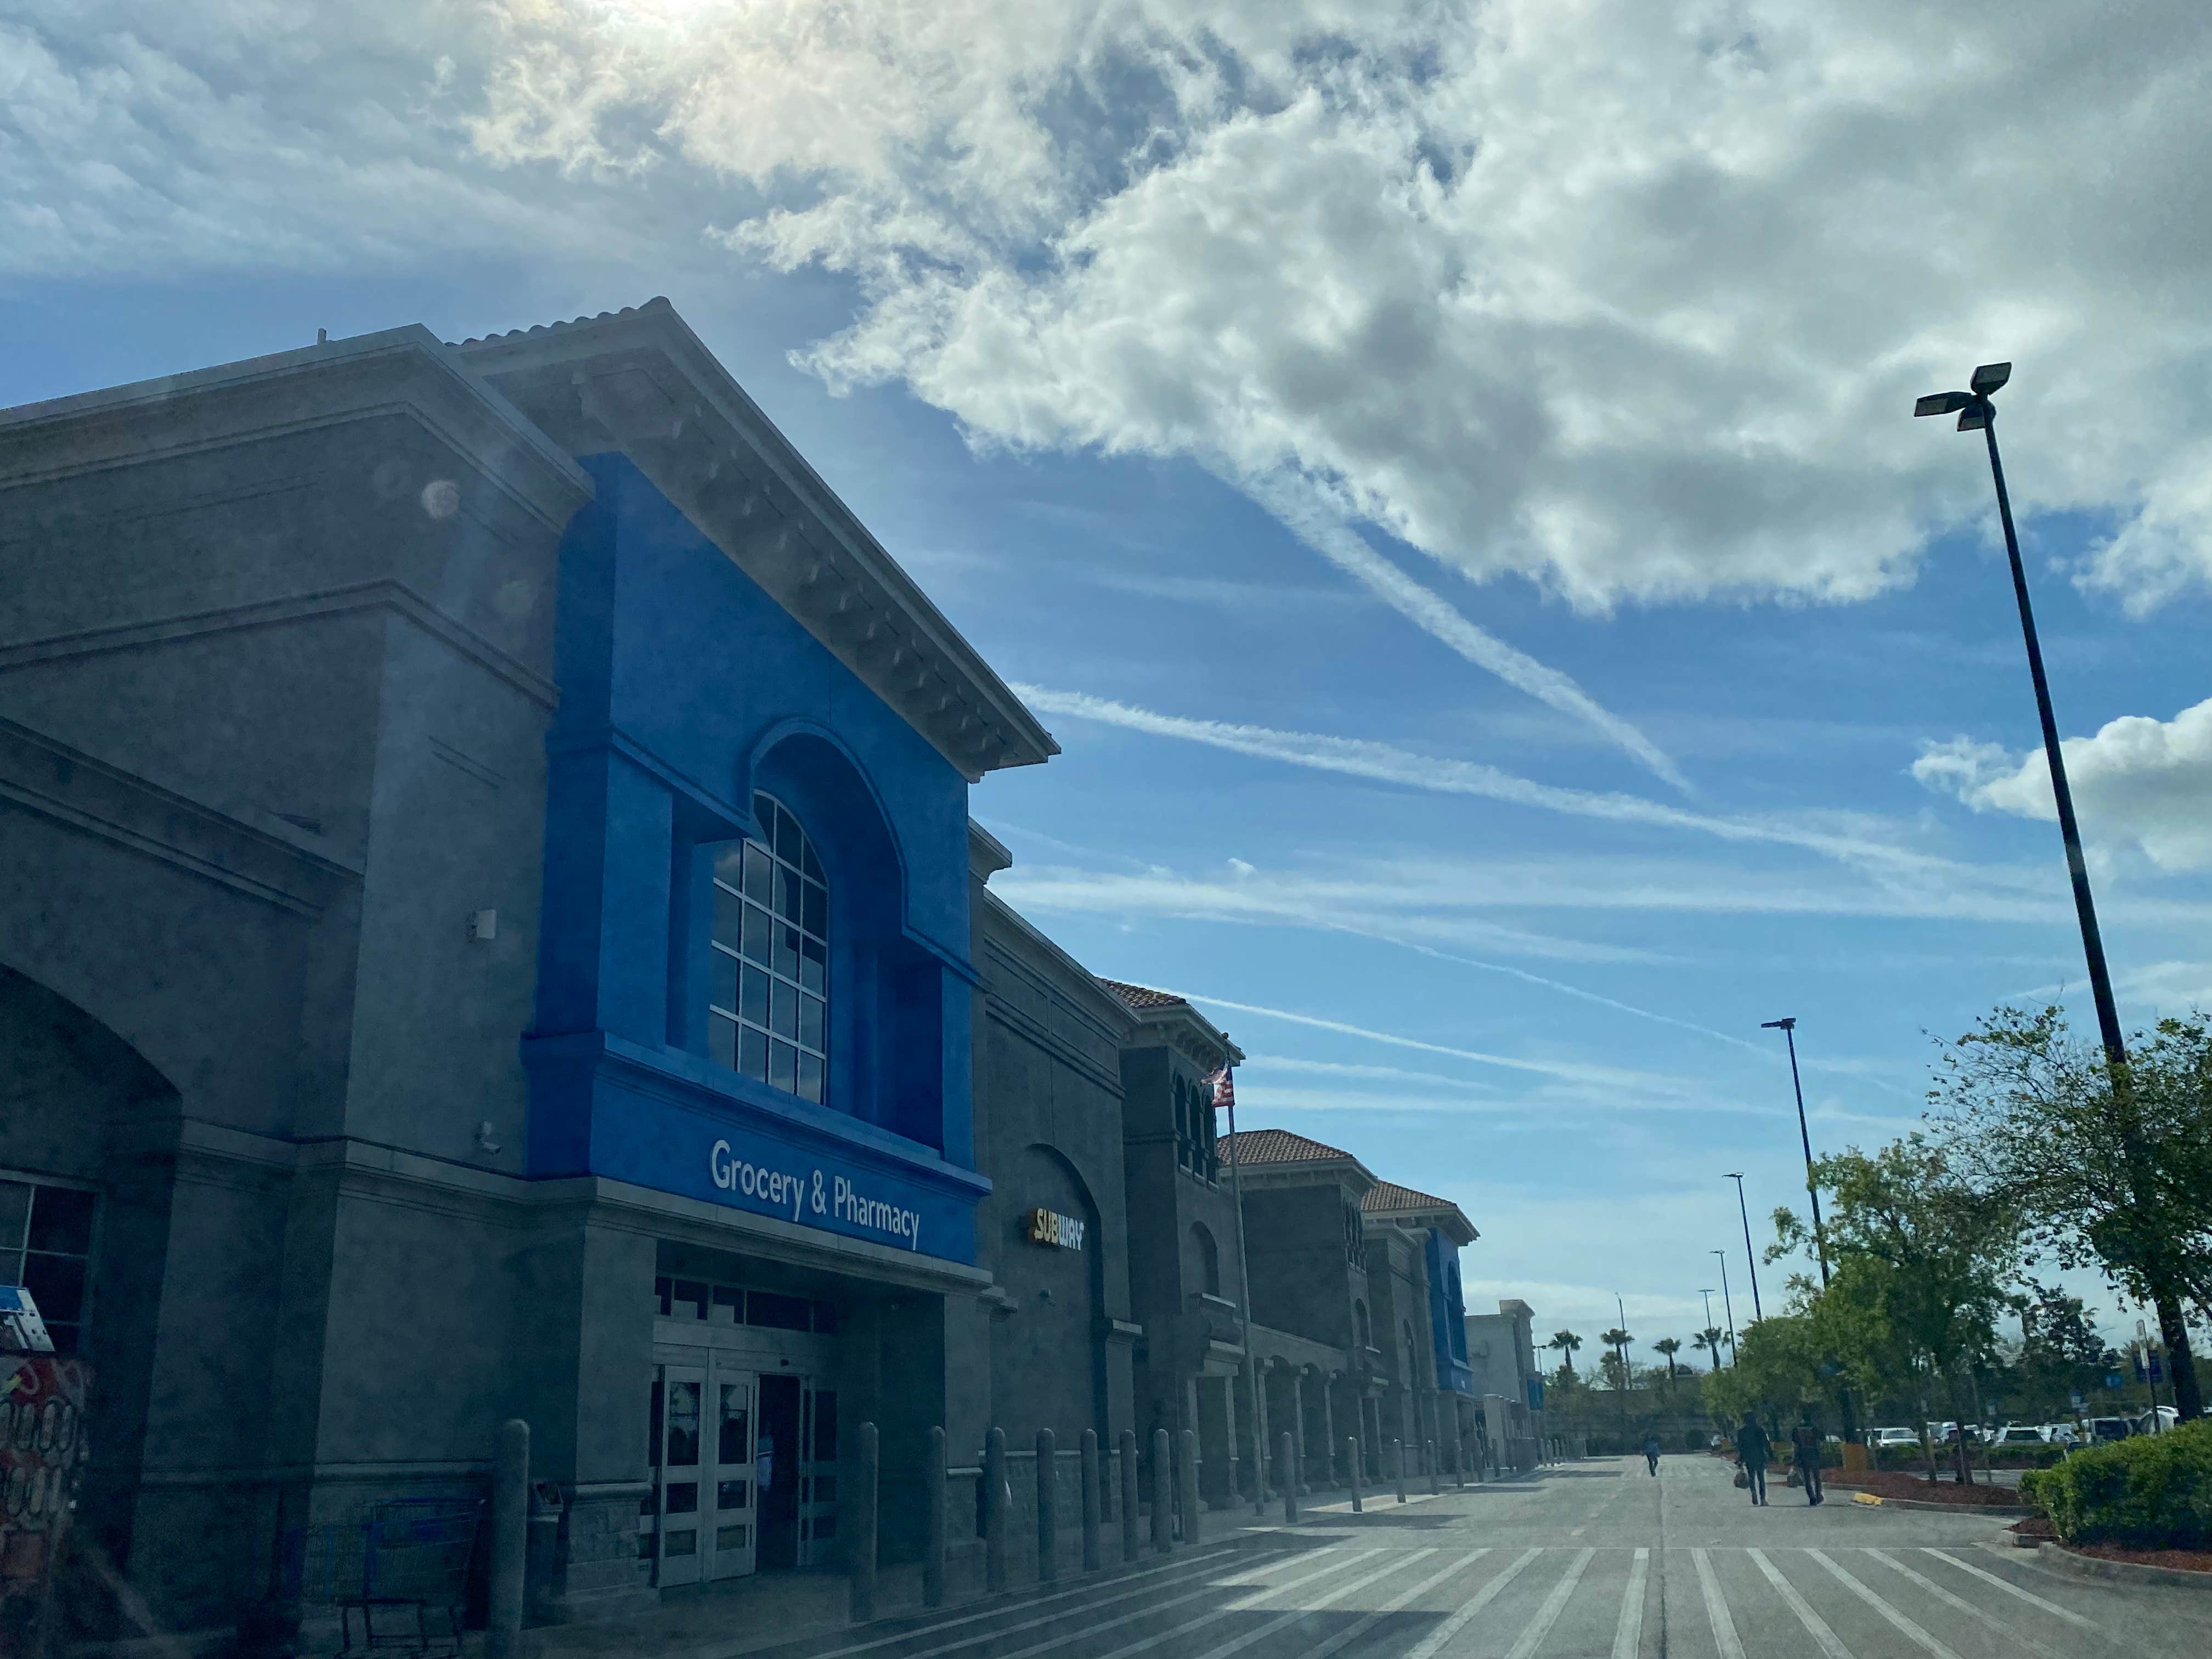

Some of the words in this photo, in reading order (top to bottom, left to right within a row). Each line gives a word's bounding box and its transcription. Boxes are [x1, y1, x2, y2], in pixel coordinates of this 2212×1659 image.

[711, 1139, 805, 1222] Grocery
[812, 1169, 827, 1215] &
[834, 1176, 919, 1251] Pharmacy
[1034, 1208, 1085, 1250] SUBWAY
